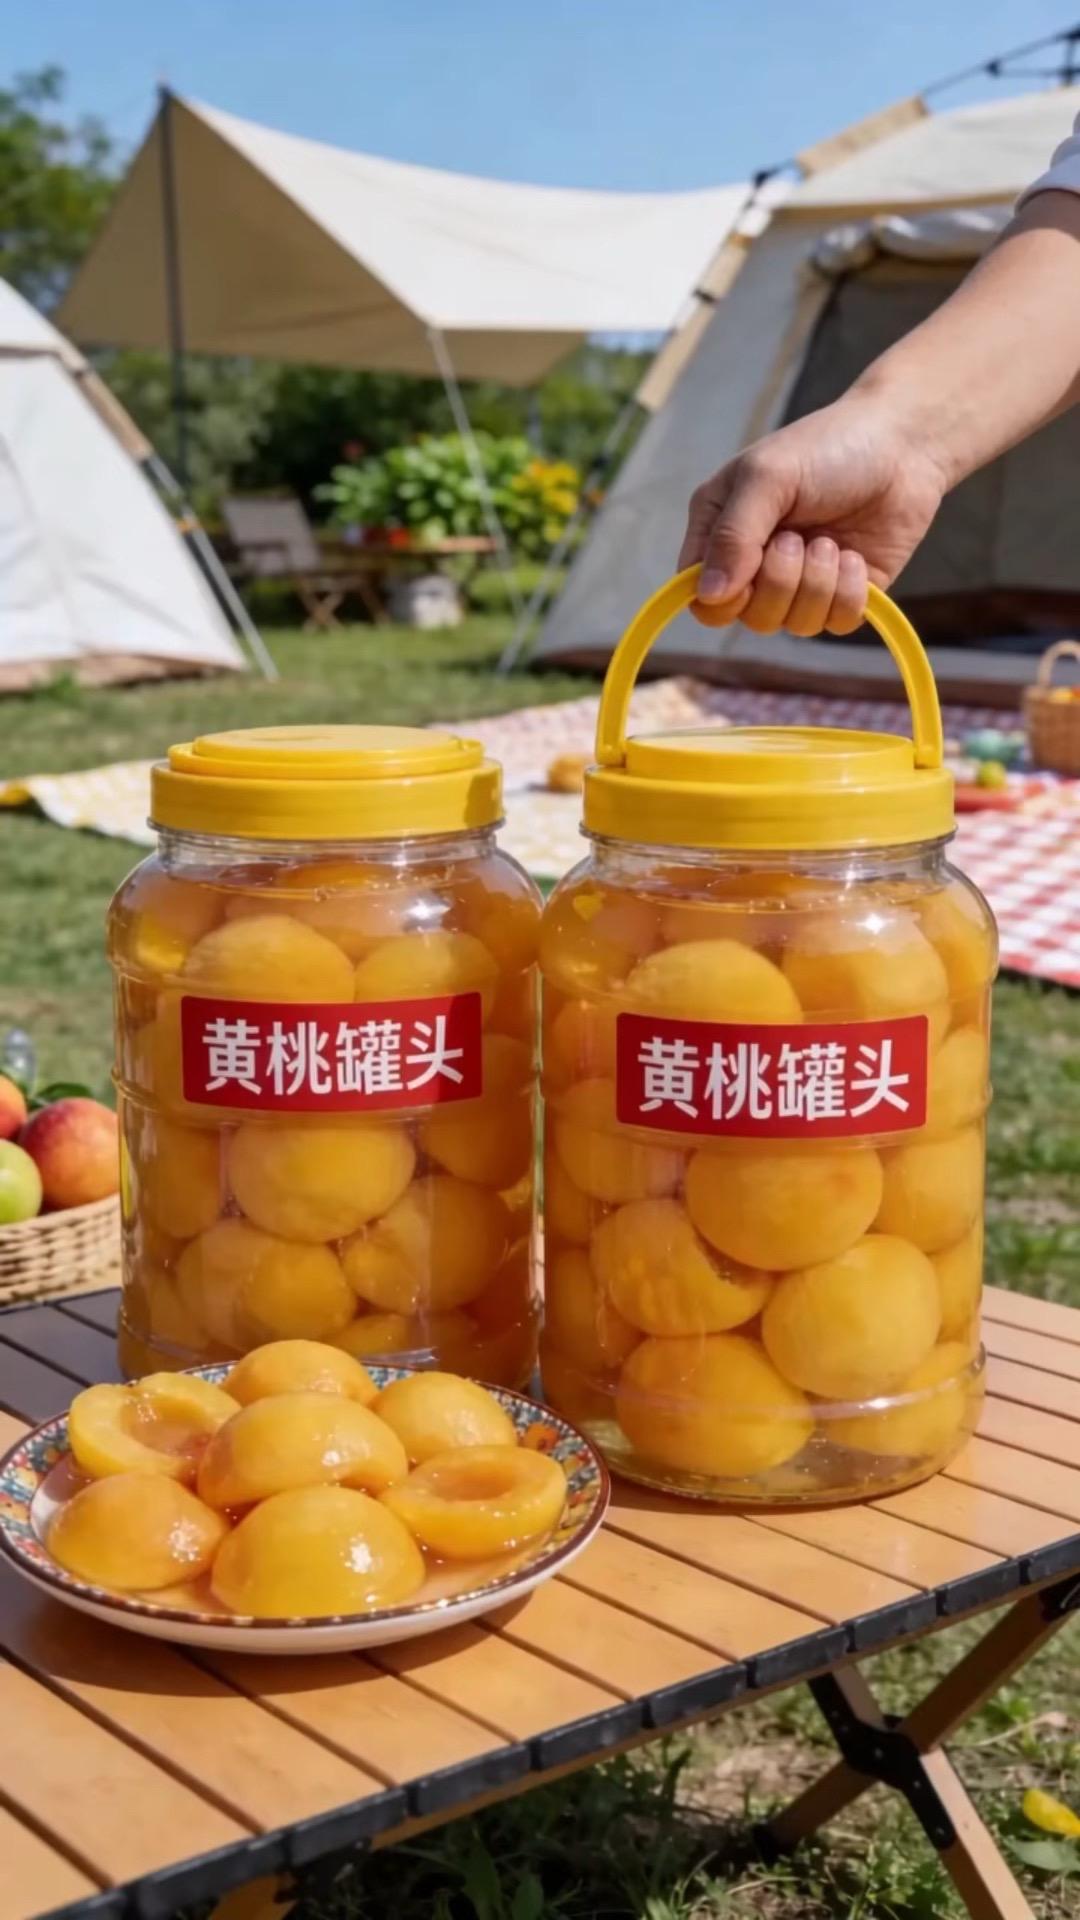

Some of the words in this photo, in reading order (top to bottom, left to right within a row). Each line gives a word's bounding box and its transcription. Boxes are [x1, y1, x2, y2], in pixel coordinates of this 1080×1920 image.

[202, 1015, 464, 1096] 黄桃罐头
[637, 1037, 909, 1121] 黄桃罐头
